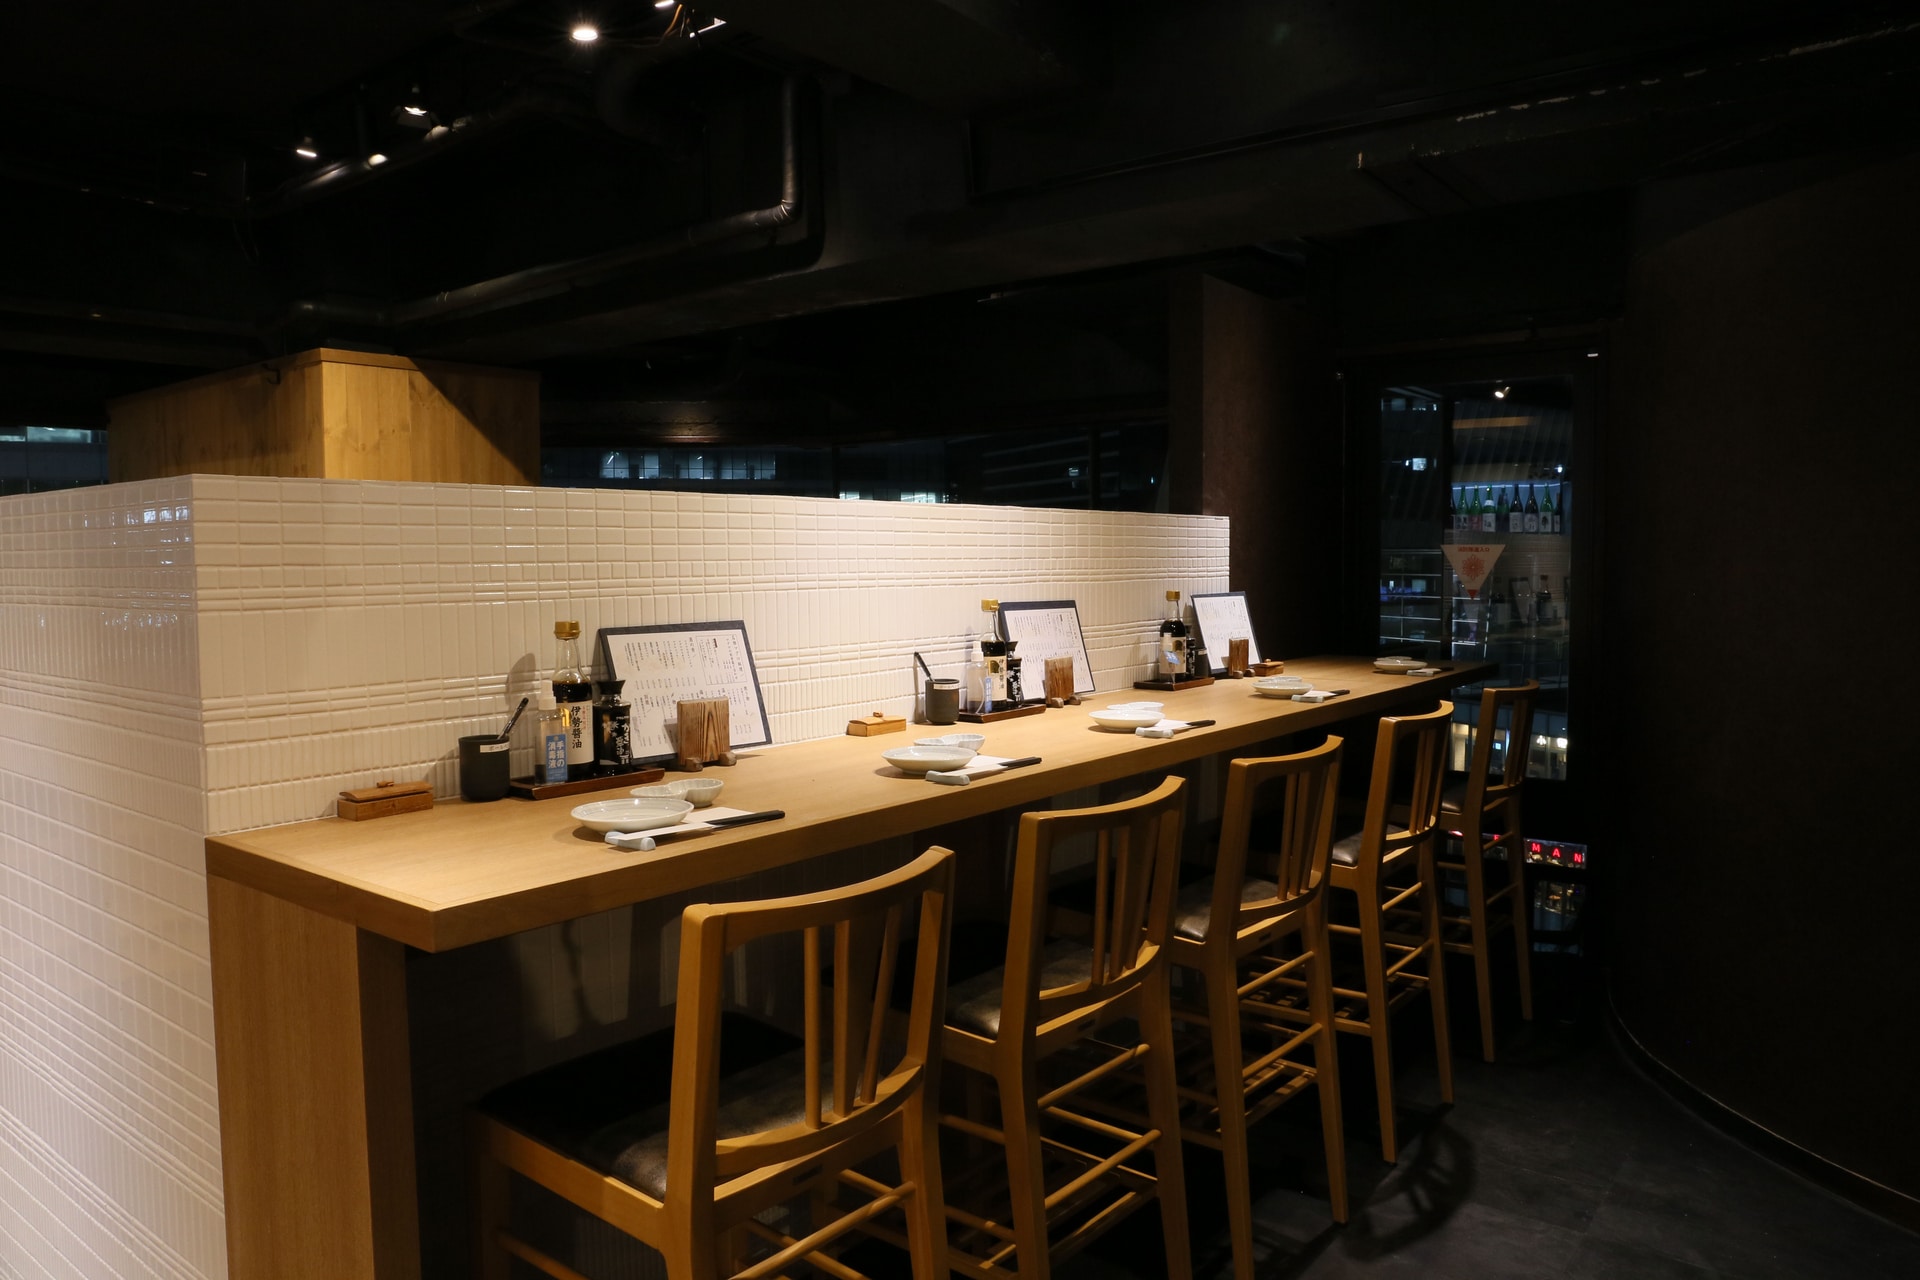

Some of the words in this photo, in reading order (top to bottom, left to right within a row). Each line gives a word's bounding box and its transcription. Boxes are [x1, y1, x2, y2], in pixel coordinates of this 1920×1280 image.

[548, 741, 557, 769] 消毒液
[556, 740, 565, 767] 手指の
